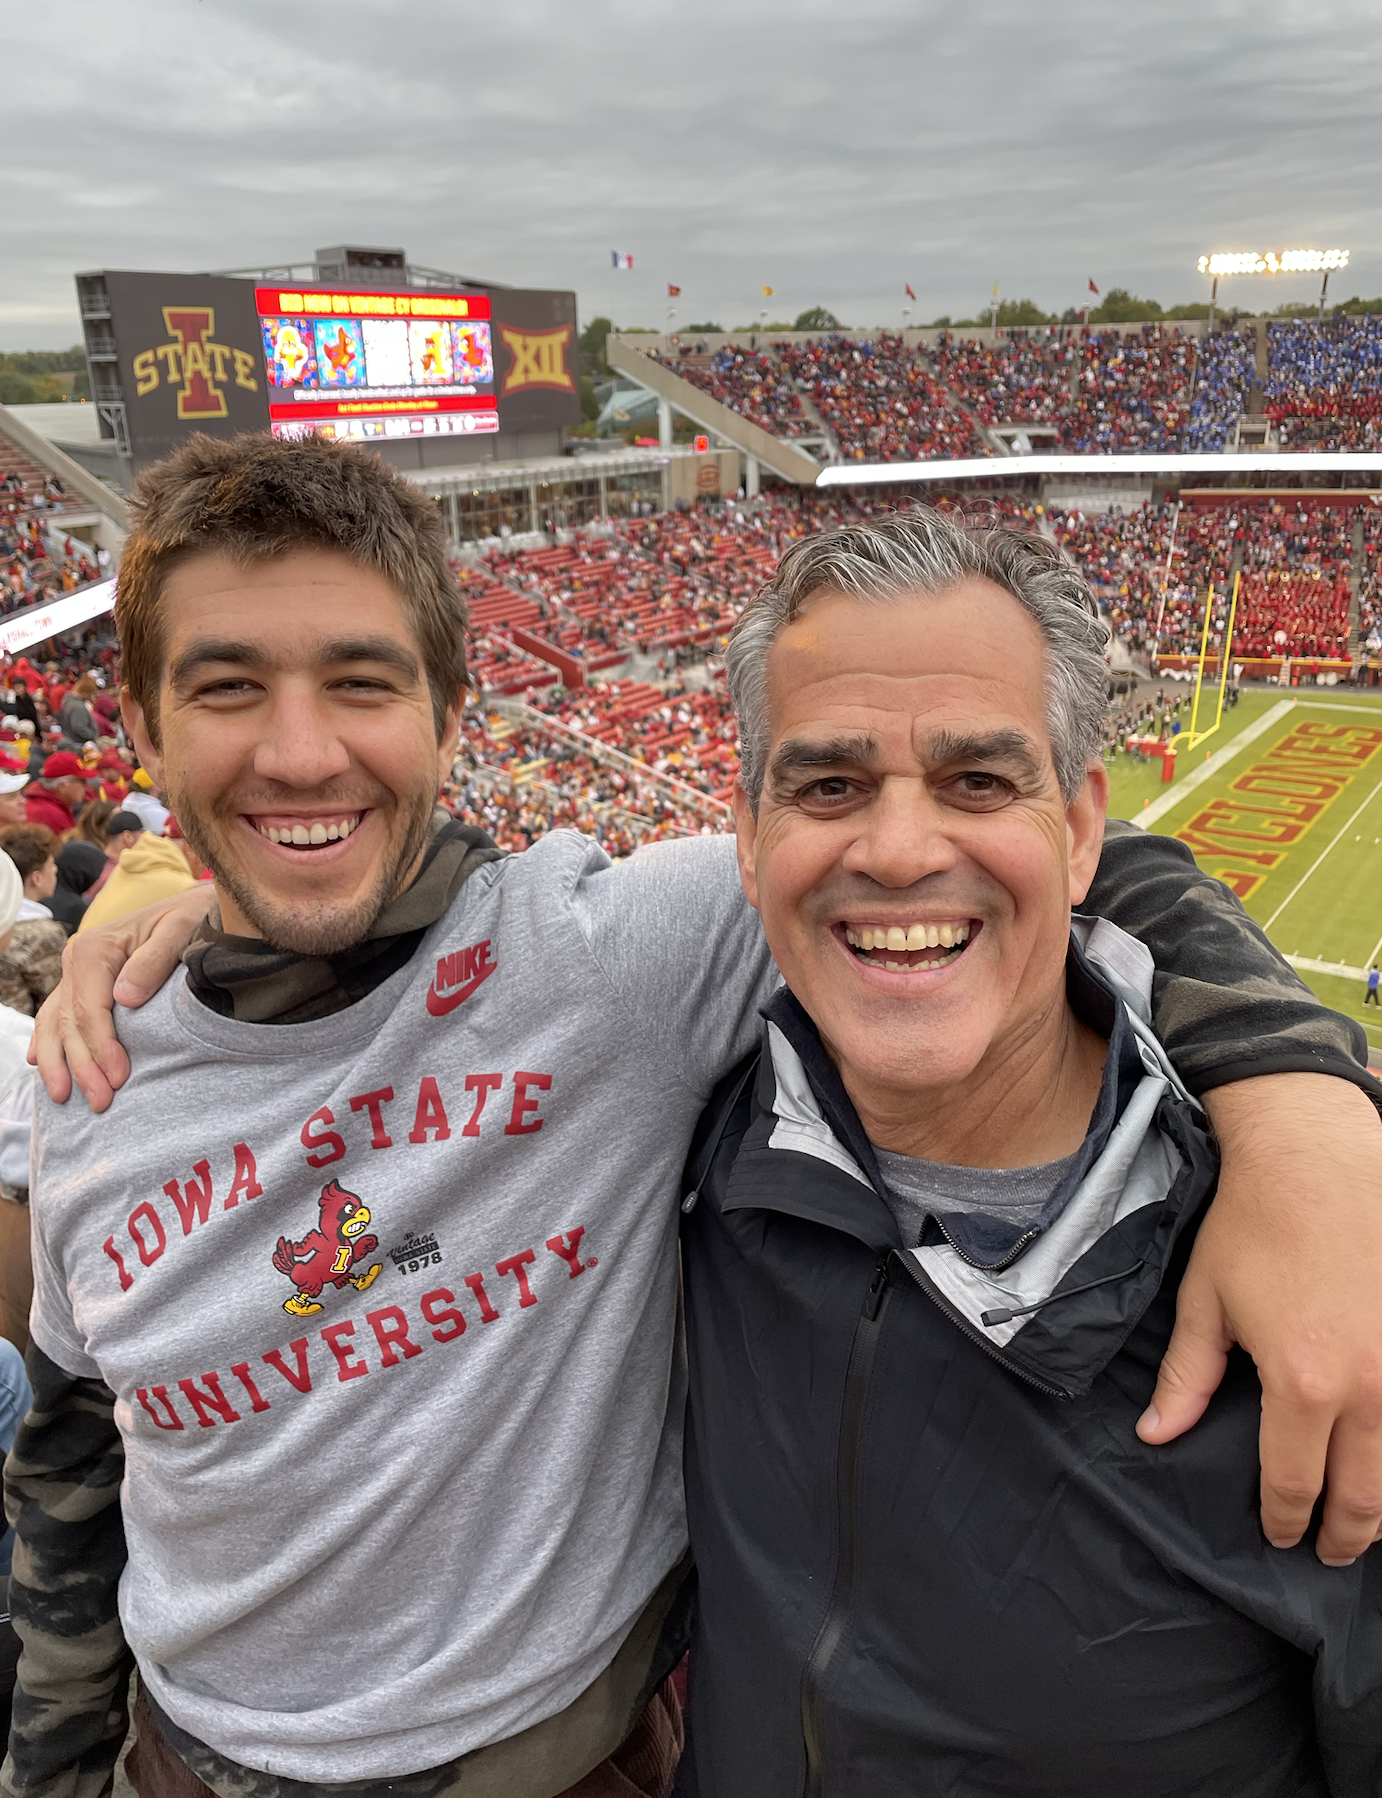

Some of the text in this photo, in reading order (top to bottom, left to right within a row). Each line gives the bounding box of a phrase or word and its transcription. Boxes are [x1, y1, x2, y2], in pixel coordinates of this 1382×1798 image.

[133, 342, 258, 396] STATE
[502, 328, 572, 390] XII
[436, 938, 492, 992] NIKE
[103, 1070, 553, 1292] IOWA STATE
[386, 1232, 435, 1258] Vintage
[397, 1251, 443, 1276] 1978
